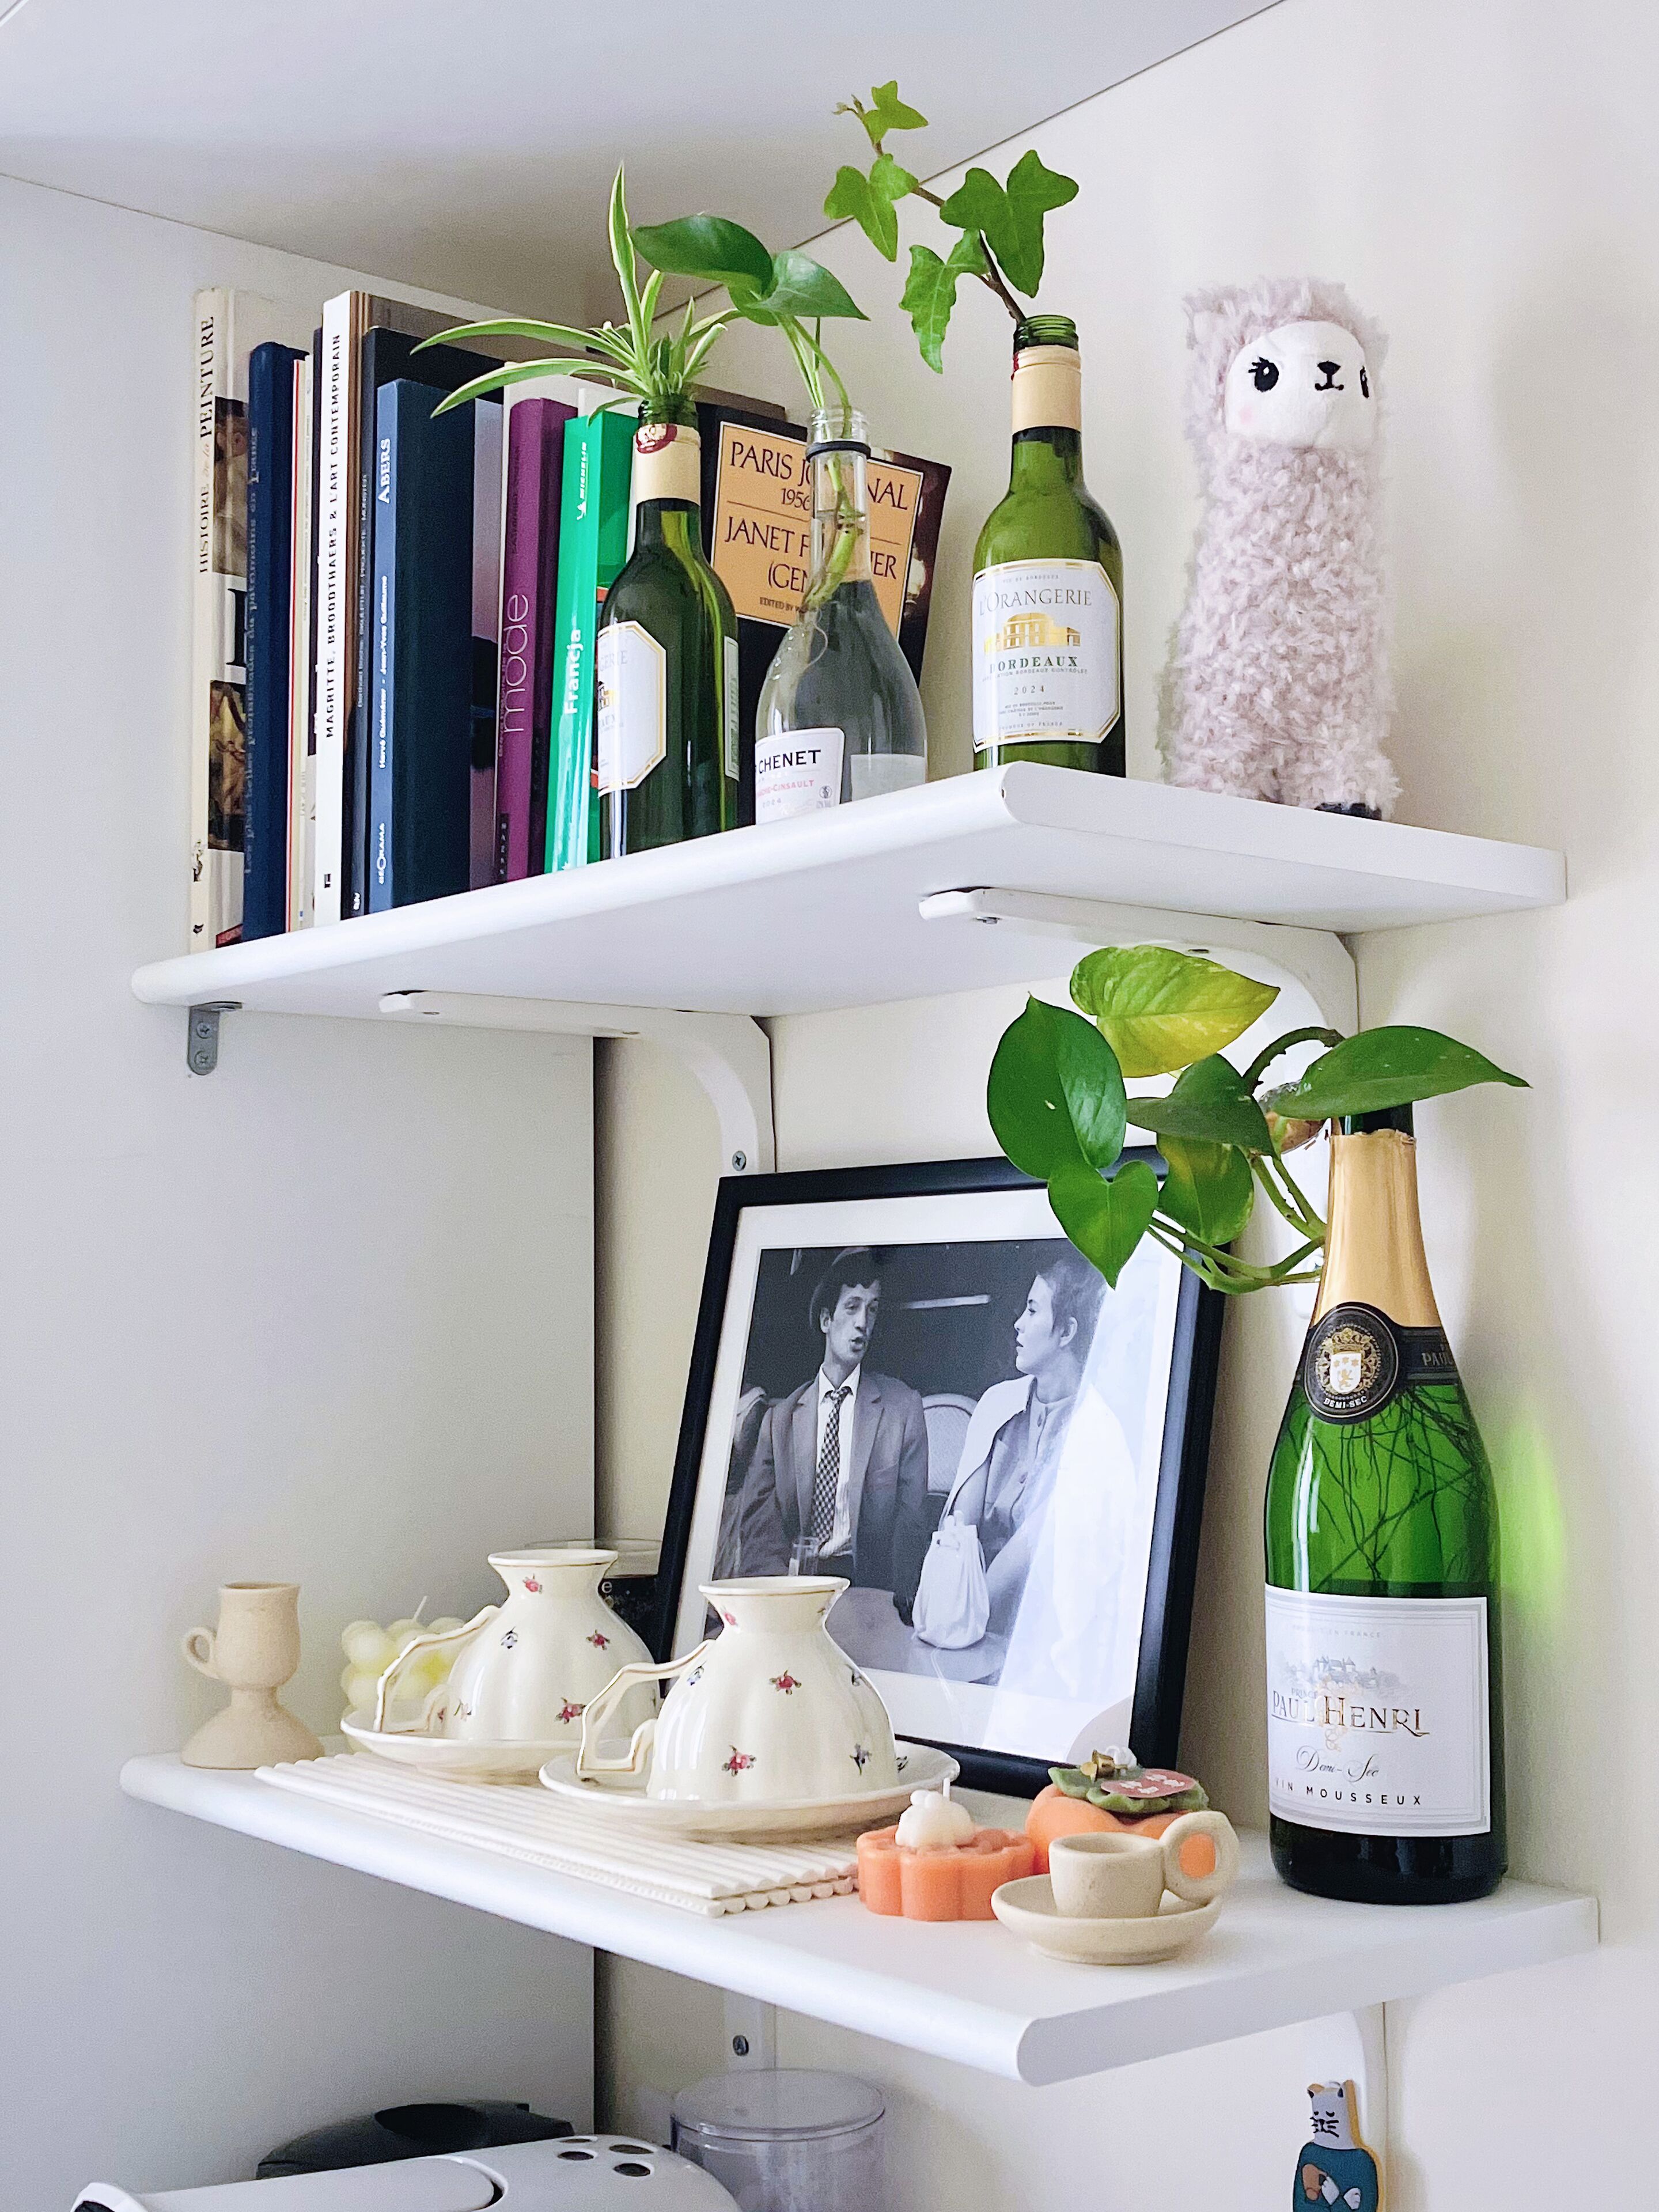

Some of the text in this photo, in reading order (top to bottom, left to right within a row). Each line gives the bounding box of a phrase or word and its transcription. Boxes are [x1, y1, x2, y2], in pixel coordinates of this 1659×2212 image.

[200, 316, 214, 438] PEINTURE
[331, 335, 340, 455] CONTEMPORAIN
[378, 438, 390, 503] ABERS
[730, 441, 793, 479] PARIS
[199, 484, 209, 573] HISTOIRE
[329, 510, 337, 520] &
[724, 516, 795, 553] JANET
[327, 528, 336, 644] BROODTHAERS
[759, 597, 785, 610] EDITED
[785, 602, 794, 611] BY
[980, 589, 1092, 616] L'ORANGERIE
[503, 595, 528, 733] mode
[565, 629, 584, 714] Francja
[1014, 685, 1044, 695] 2024
[759, 749, 821, 774] CHENET
[1324, 1396, 1368, 1409] DEMI-SEC
[1344, 1630, 1381, 1638] FRANCE
[1273, 1691, 1430, 1737] PAUL HENRI
[1306, 1786, 1421, 1805] MOUSSEUX
